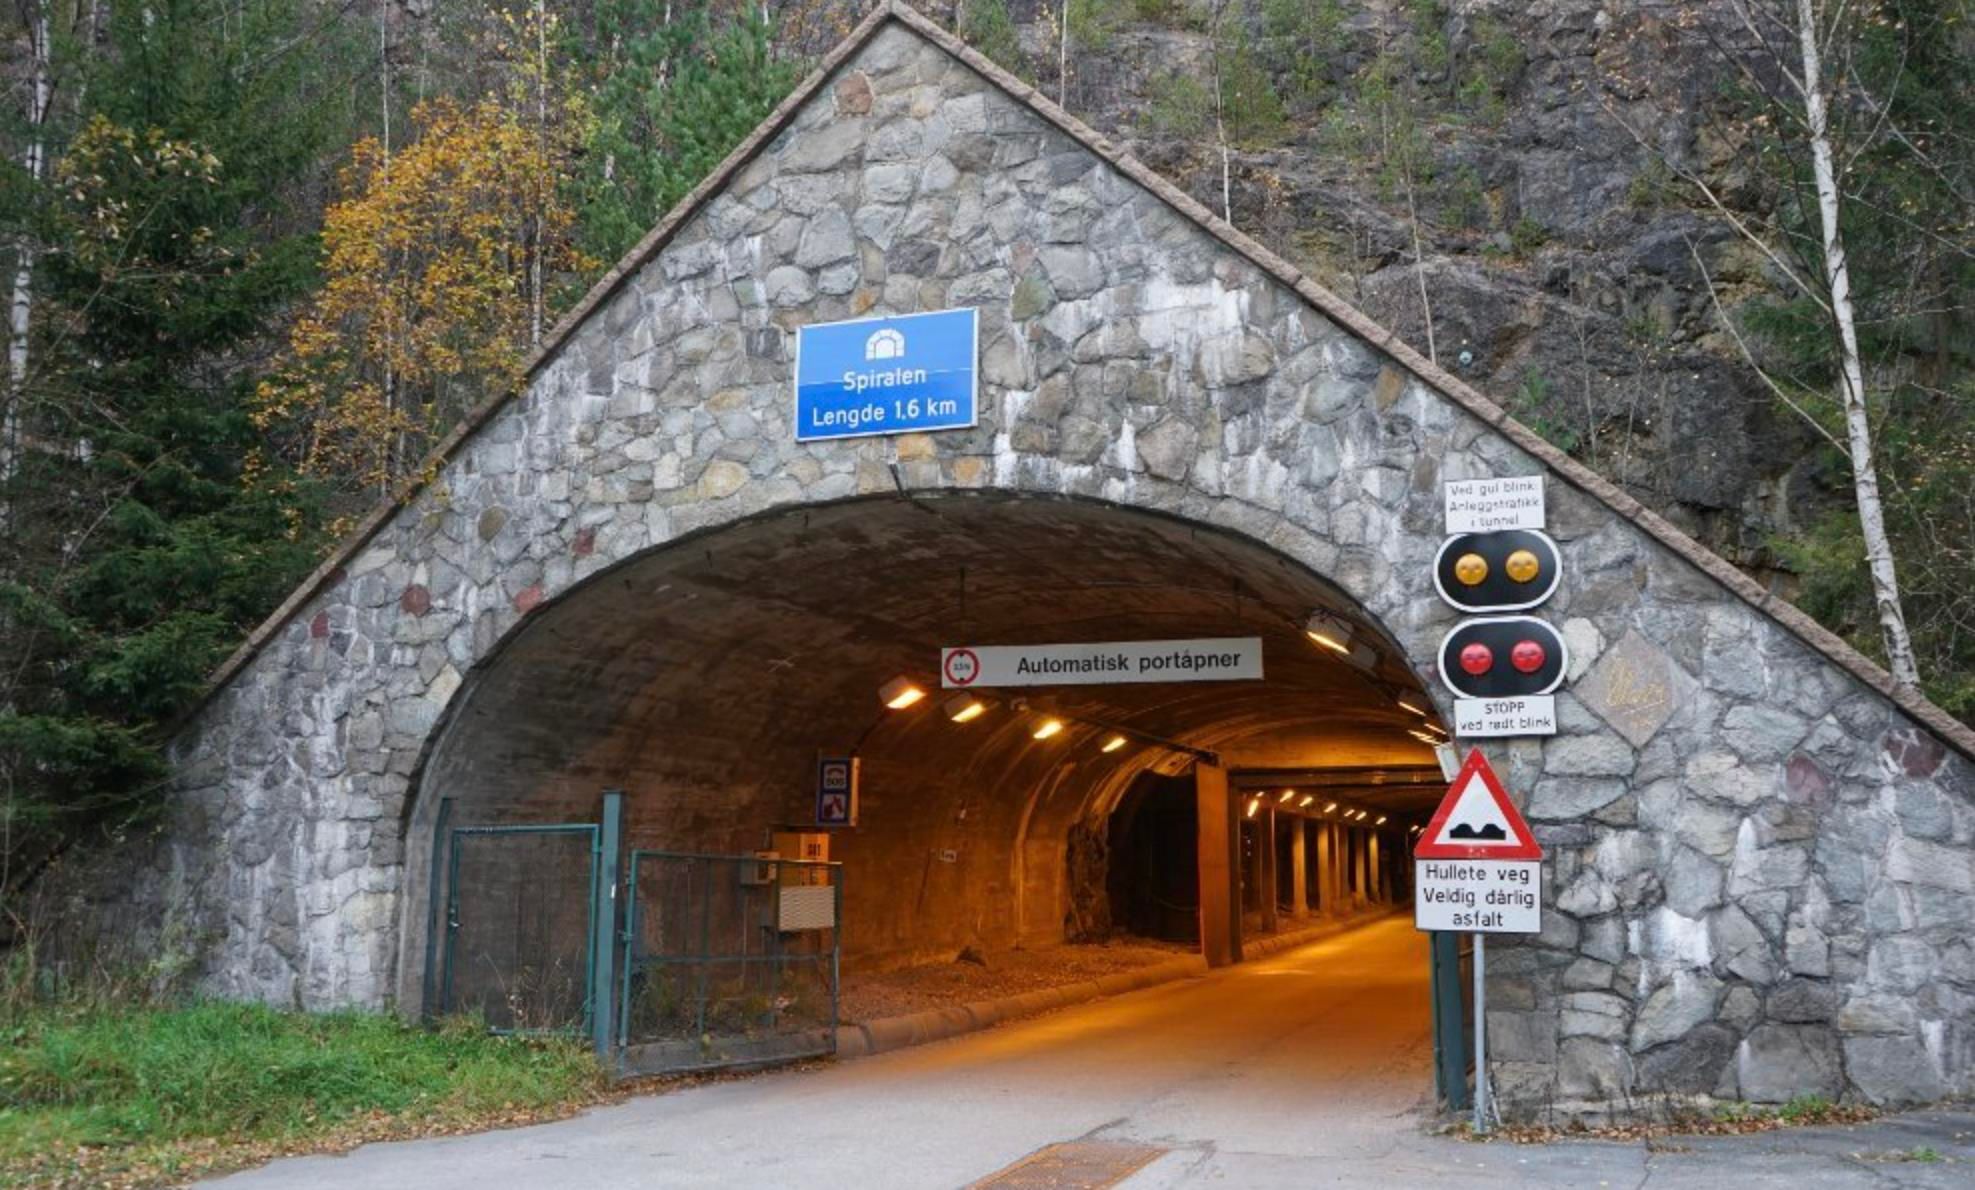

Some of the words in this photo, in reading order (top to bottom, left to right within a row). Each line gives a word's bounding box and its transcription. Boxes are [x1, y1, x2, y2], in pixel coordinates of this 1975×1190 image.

[843, 368, 927, 393] Spiralen
[812, 403, 886, 428] Lengde
[927, 397, 957, 416] km
[1450, 485, 1473, 495] Ved
[1479, 483, 1499, 497] gul
[1479, 512, 1519, 527] tunnel
[1017, 655, 1128, 674] Automatisk
[1139, 649, 1241, 673] portåpner
[1484, 701, 1525, 714] STOPP
[1461, 719, 1483, 730] ved
[1519, 716, 1551, 729] blink
[1425, 864, 1487, 881] Hullete
[1497, 869, 1530, 885] veg
[1423, 888, 1476, 908] Veldig
[1485, 889, 1535, 909] dårlig
[1452, 911, 1504, 927] asfalt
